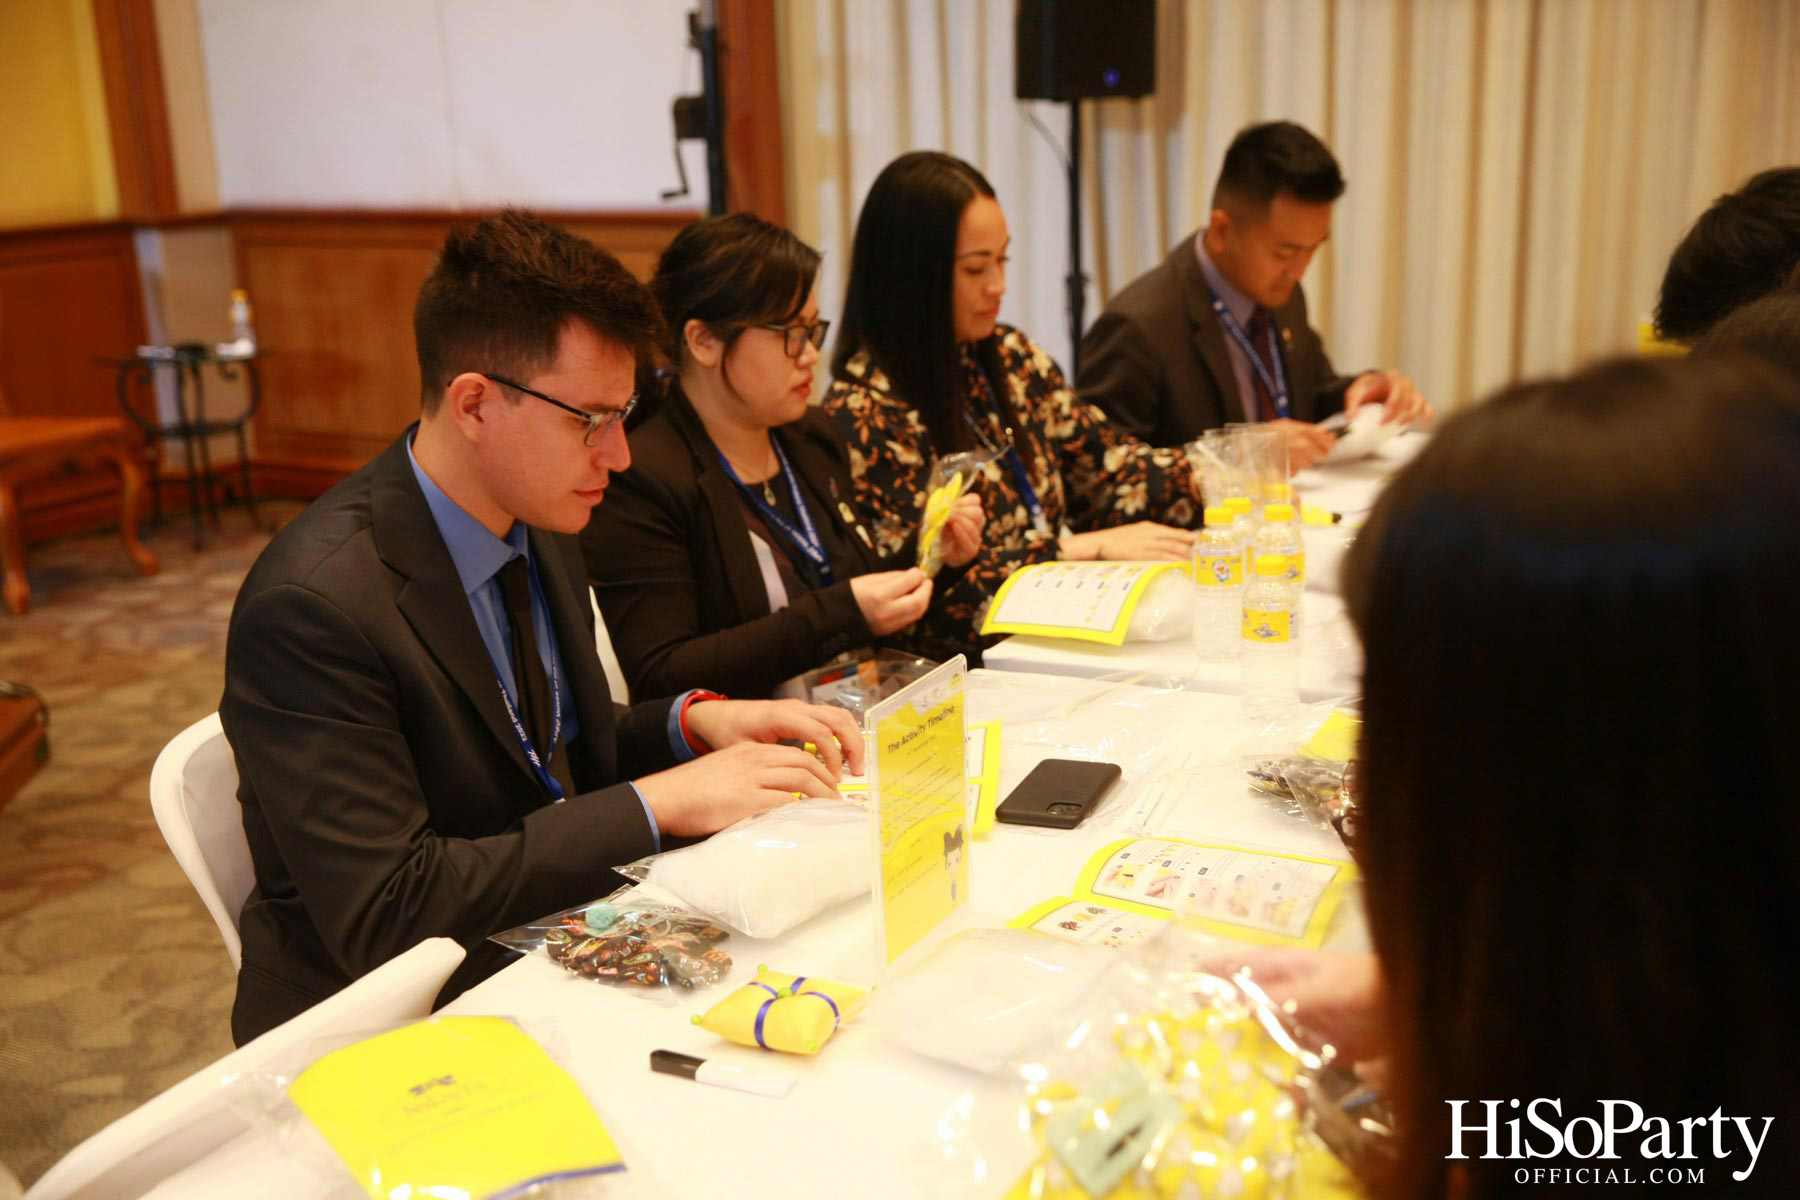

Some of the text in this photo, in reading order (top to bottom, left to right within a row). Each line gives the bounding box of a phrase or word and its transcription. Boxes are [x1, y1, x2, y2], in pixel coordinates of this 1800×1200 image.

[887, 741, 900, 755] The
[901, 725, 926, 746] Activity
[928, 705, 955, 728] Timeline
